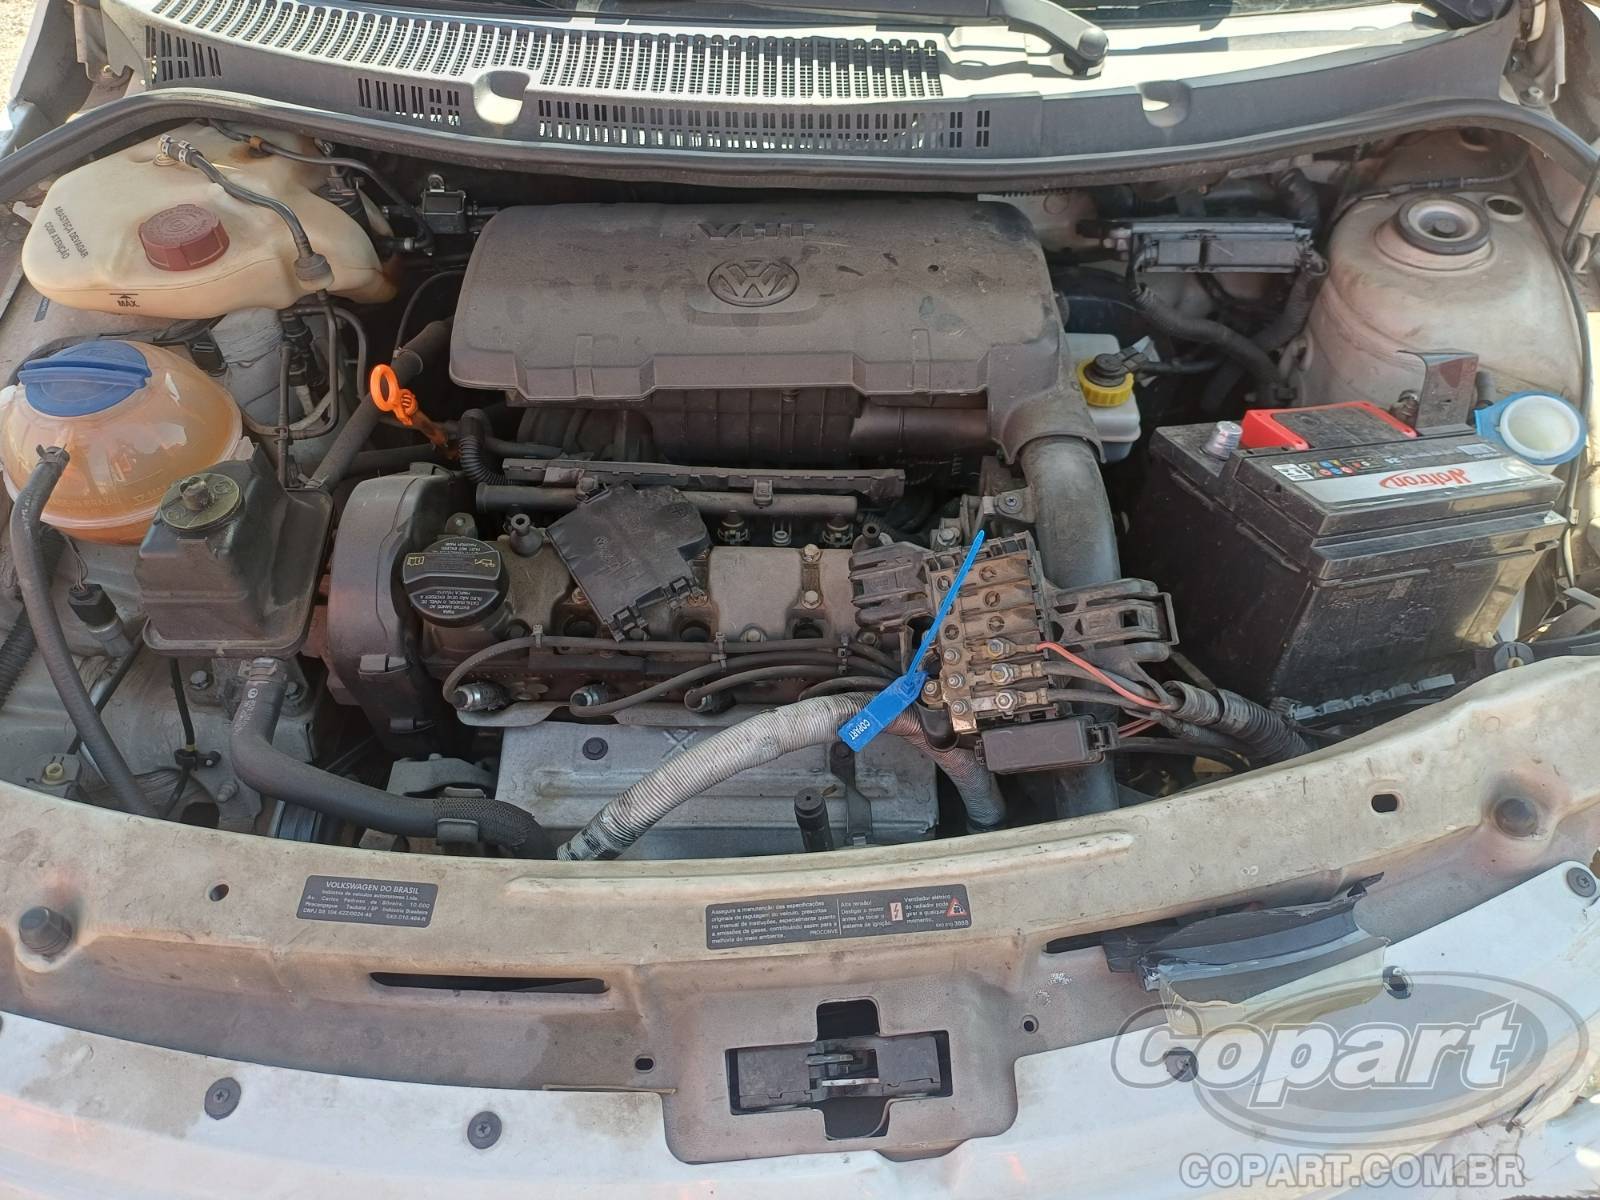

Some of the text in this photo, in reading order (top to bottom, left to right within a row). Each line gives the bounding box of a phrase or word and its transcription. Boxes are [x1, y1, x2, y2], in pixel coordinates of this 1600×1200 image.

[1381, 467, 1472, 490] Voltron
[849, 718, 870, 740] COPART
[325, 881, 379, 891] VOLKSWAGEN
